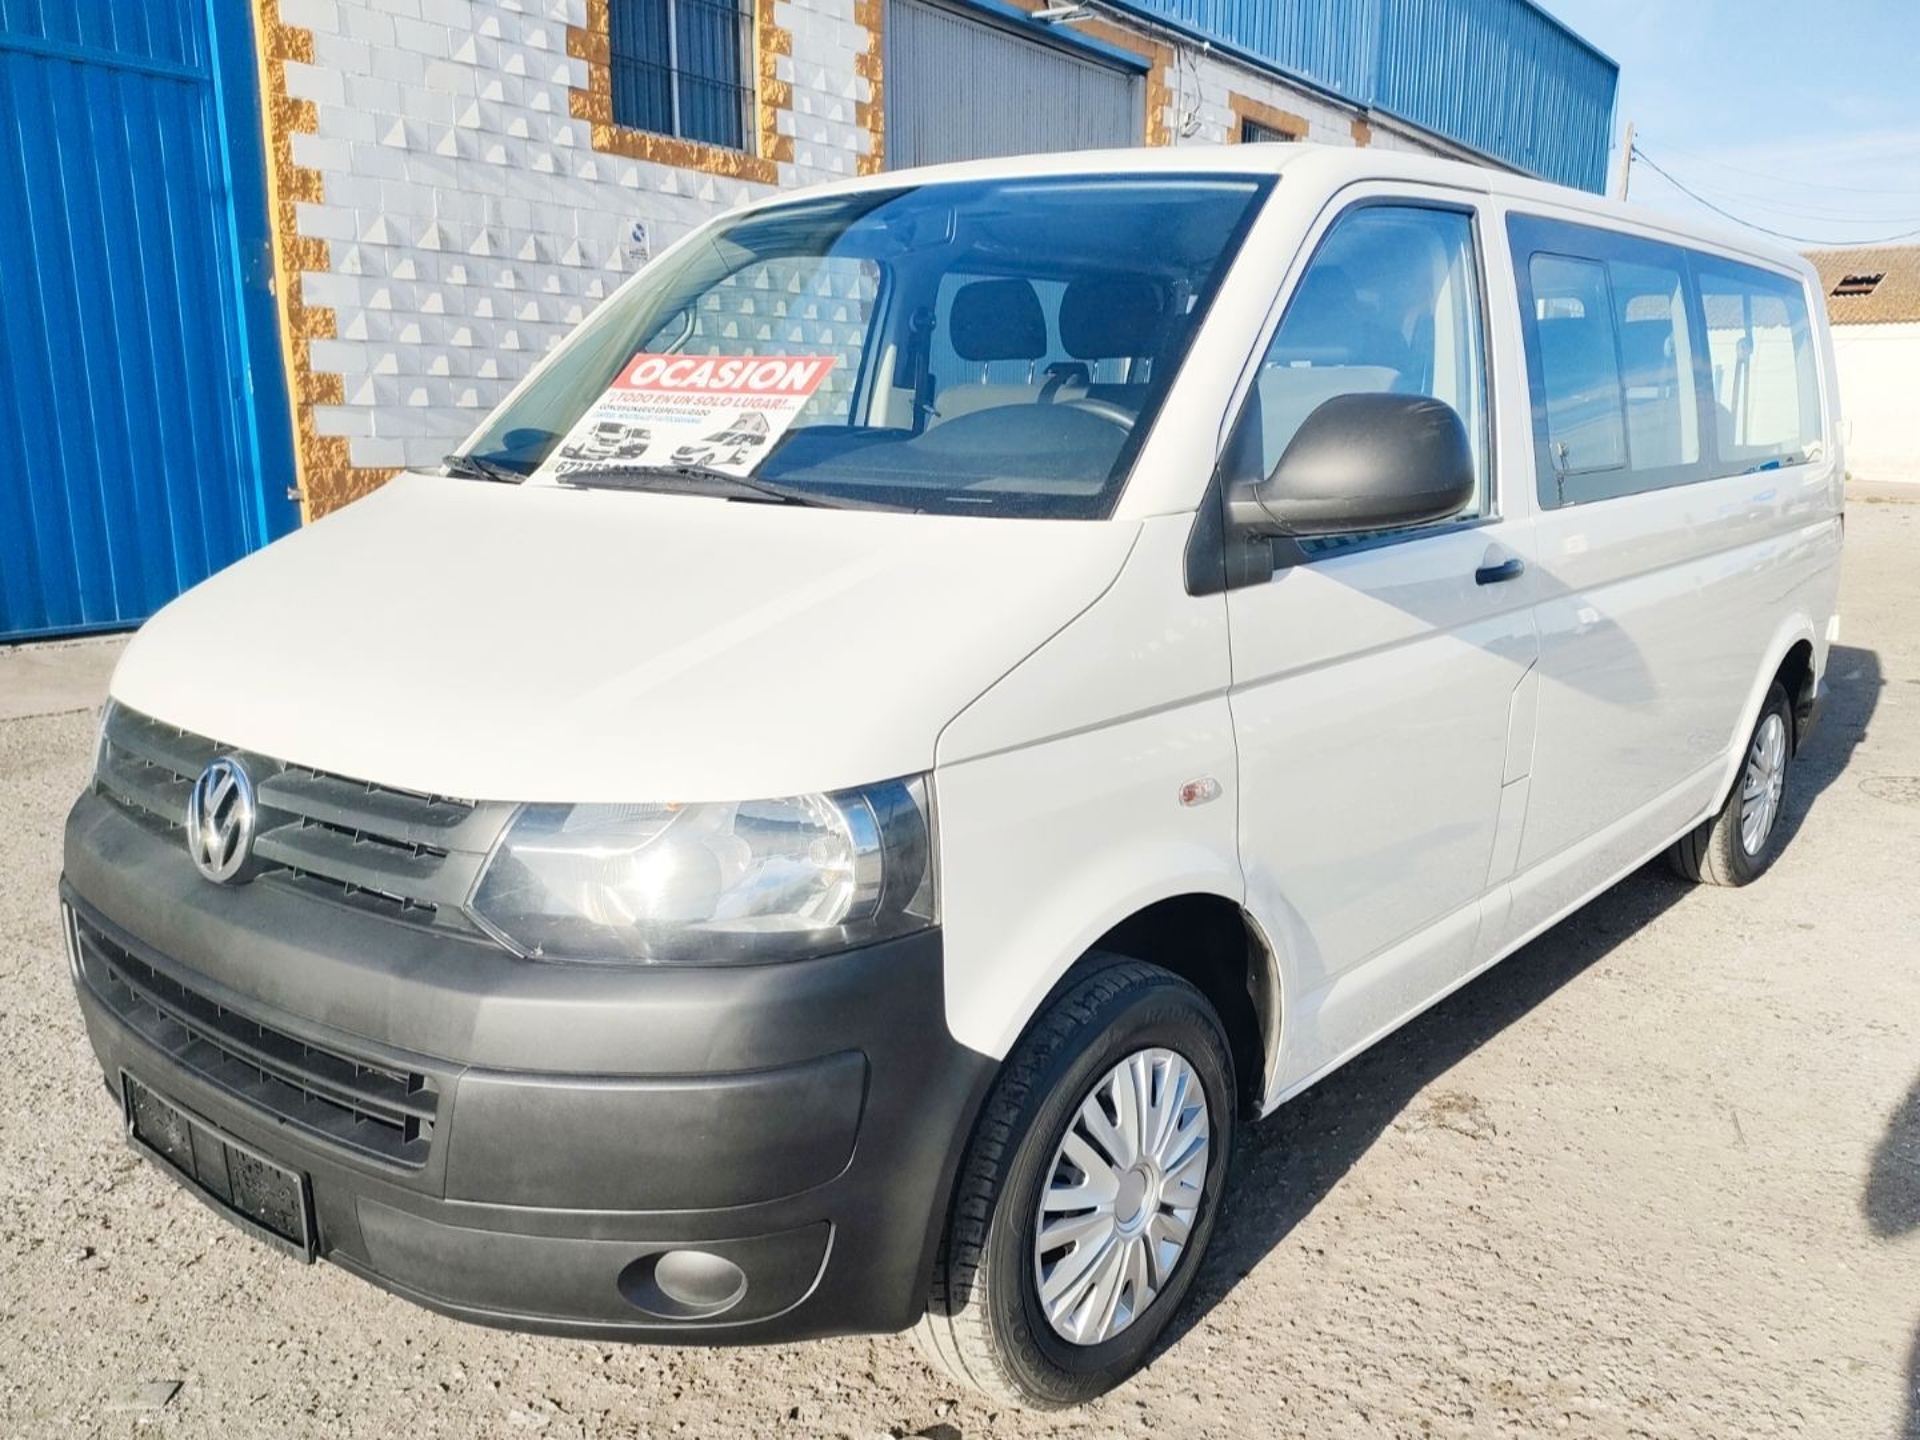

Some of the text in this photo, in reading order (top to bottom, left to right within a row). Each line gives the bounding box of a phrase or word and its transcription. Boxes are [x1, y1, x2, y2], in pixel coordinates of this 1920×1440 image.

[629, 358, 822, 390] OCASION
[653, 393, 676, 405] EN
[673, 394, 696, 406] UN
[694, 396, 733, 408] SOLO
